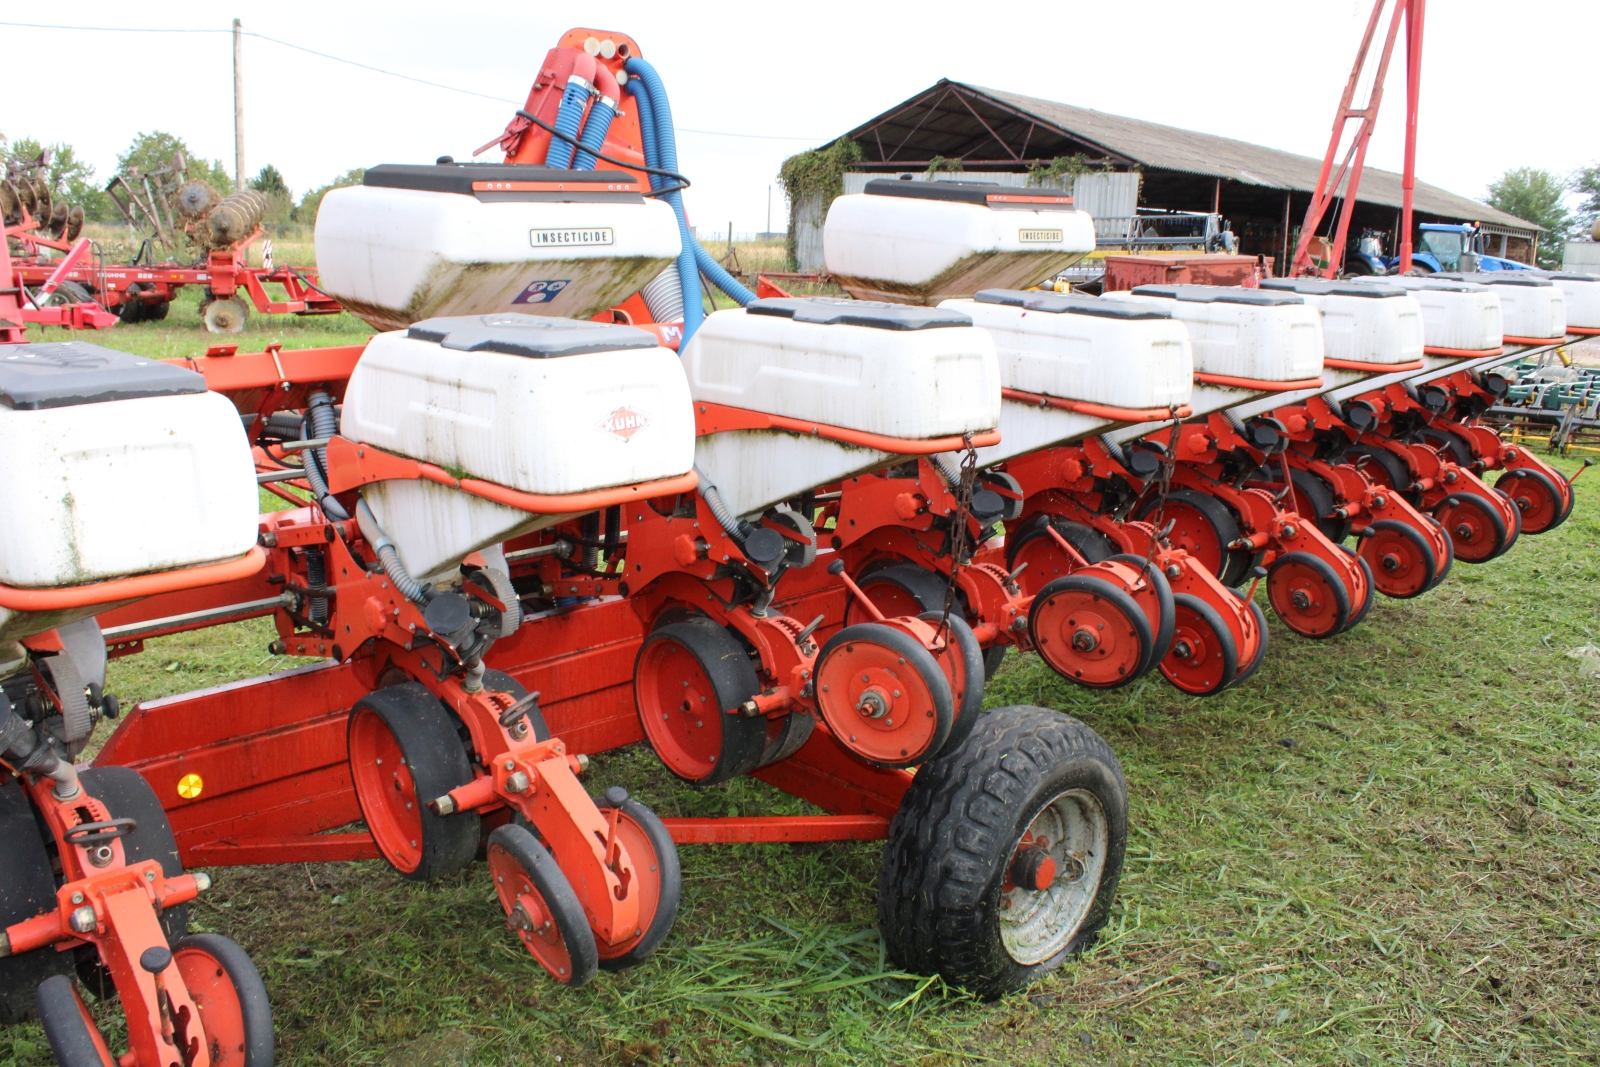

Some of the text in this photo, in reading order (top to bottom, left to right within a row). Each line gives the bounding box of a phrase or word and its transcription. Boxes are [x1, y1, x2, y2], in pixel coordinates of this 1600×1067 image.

[537, 231, 607, 243] INSECTICIDE
[1022, 232, 1060, 240] INSECTICIDE
[605, 415, 645, 432] KUHN
